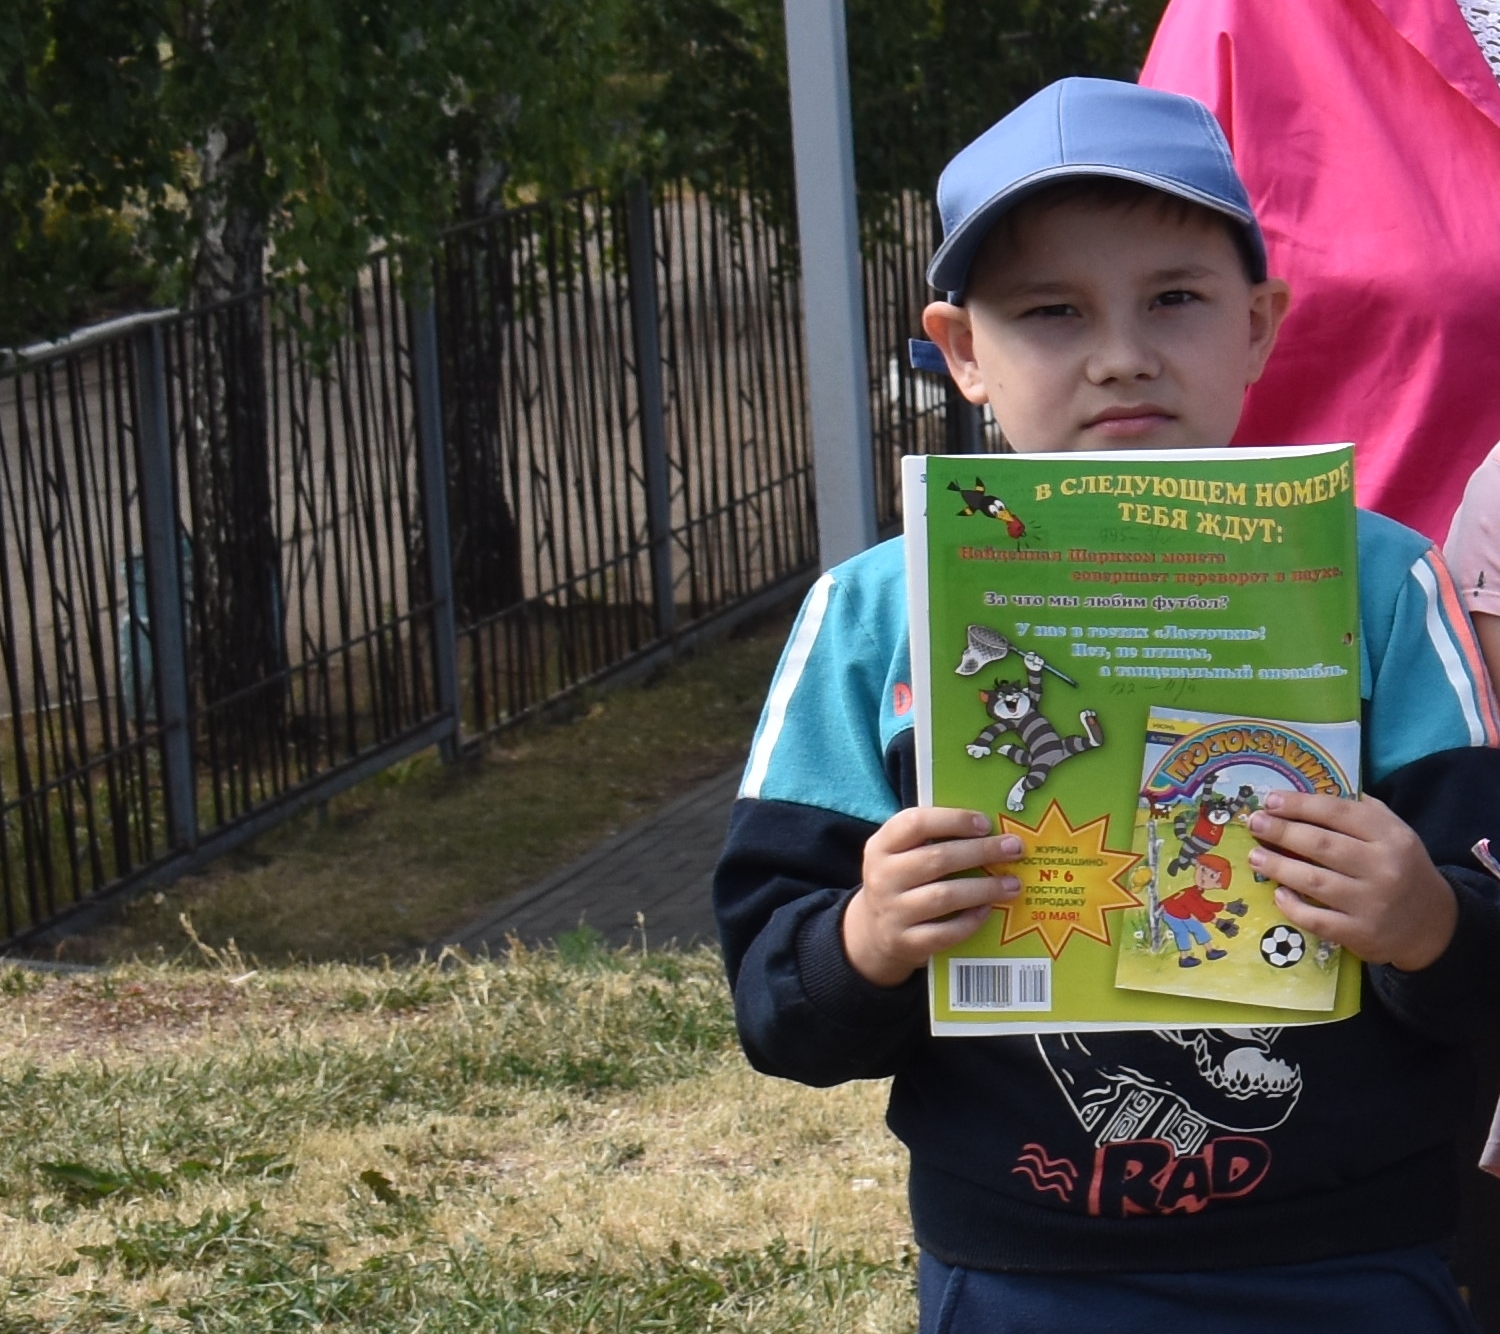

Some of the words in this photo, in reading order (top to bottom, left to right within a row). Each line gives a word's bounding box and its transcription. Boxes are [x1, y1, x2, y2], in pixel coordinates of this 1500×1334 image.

[1061, 476, 1246, 507] СЛЕДУЮЩЕМ
[1255, 461, 1351, 508] НОМЕРЕ
[1117, 502, 1188, 531] ТЕБЯ
[1197, 513, 1283, 543] ЖДУТ:
[960, 547, 1061, 562] Найденная
[1068, 549, 1155, 564] Шариком
[1161, 551, 1225, 563] монета
[985, 593, 1007, 606] За
[1013, 596, 1042, 608] что
[1048, 597, 1078, 608] мы
[1085, 595, 1146, 608] любим
[1152, 595, 1228, 611] футбол?
[1072, 644, 1107, 658] Нет,
[1116, 647, 1137, 657] не
[1142, 646, 1211, 661] птицы,
[1039, 870, 1058, 882] №
[1064, 871, 1073, 882] 6
[1088, 1137, 1271, 1217] RAD
